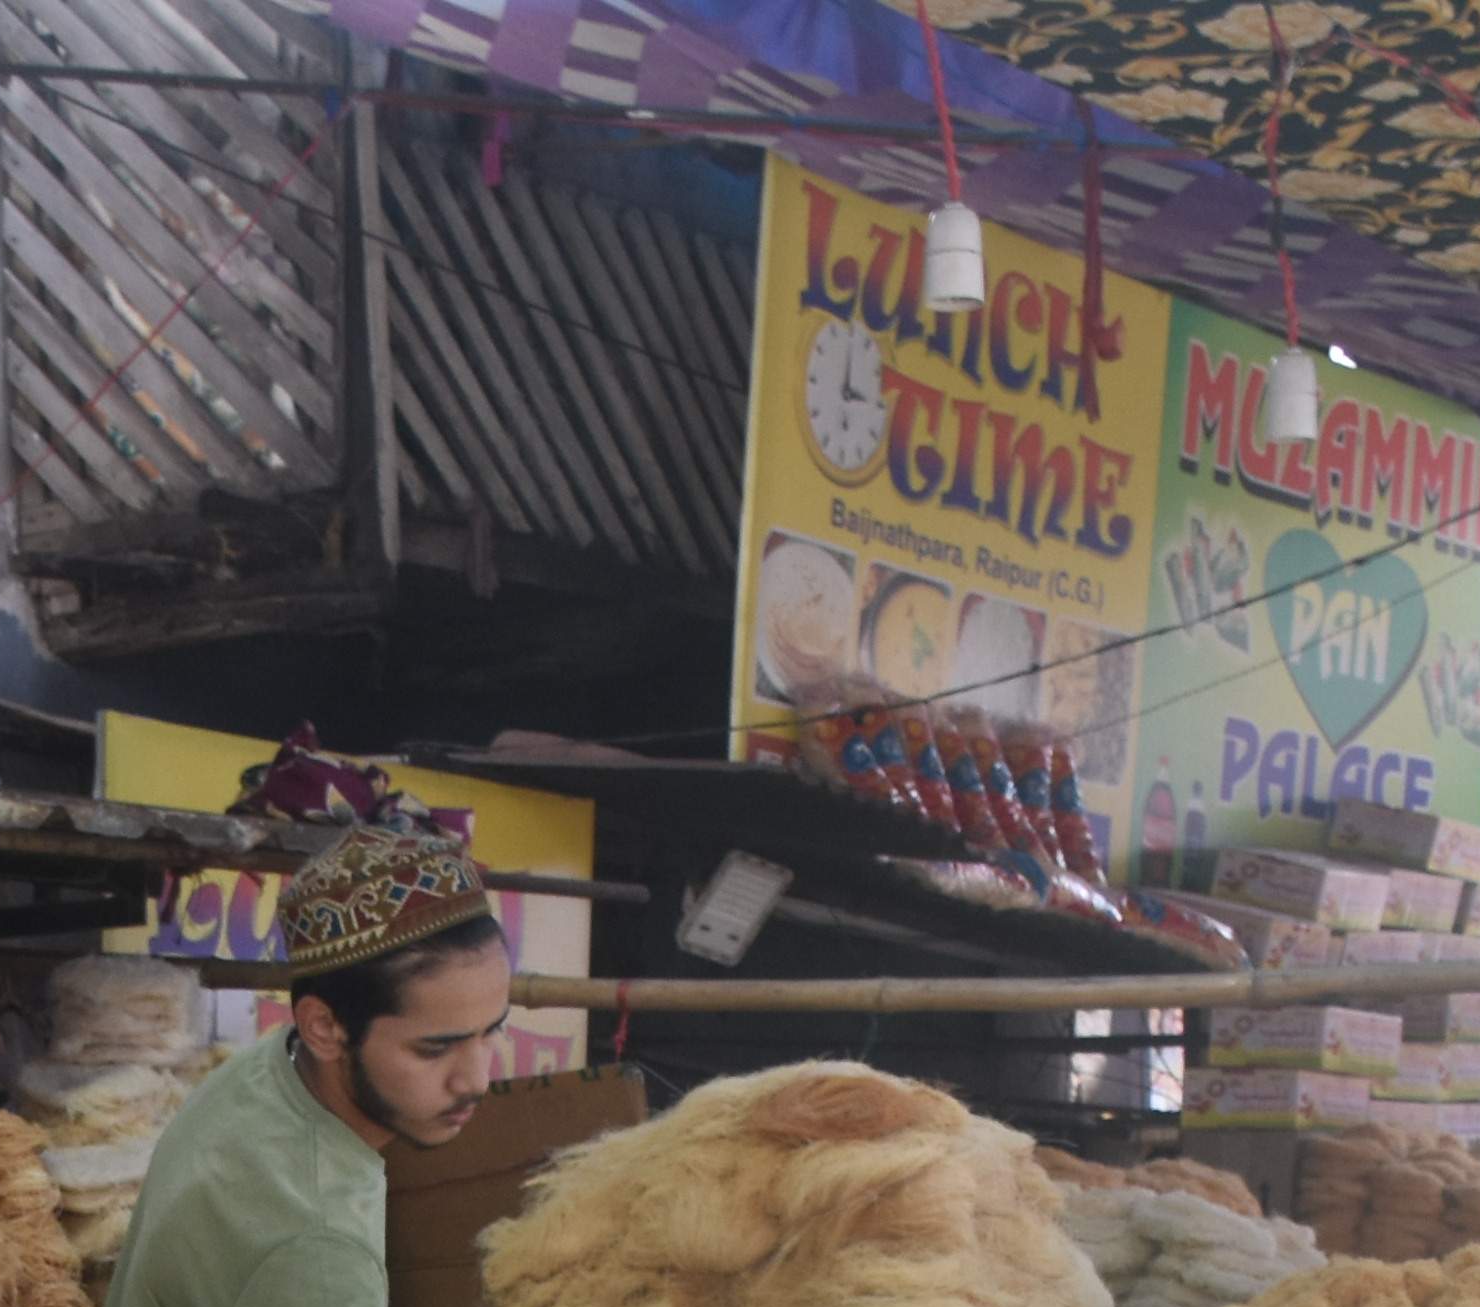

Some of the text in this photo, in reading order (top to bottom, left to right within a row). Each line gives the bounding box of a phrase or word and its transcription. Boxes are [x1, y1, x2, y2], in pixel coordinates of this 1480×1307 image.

[880, 362, 1135, 561] TIME
[829, 496, 1107, 613] Baijnathpara, Raipur (C.G.)
[1289, 578, 1394, 687] PAN
[1220, 715, 1435, 822] PALACE
